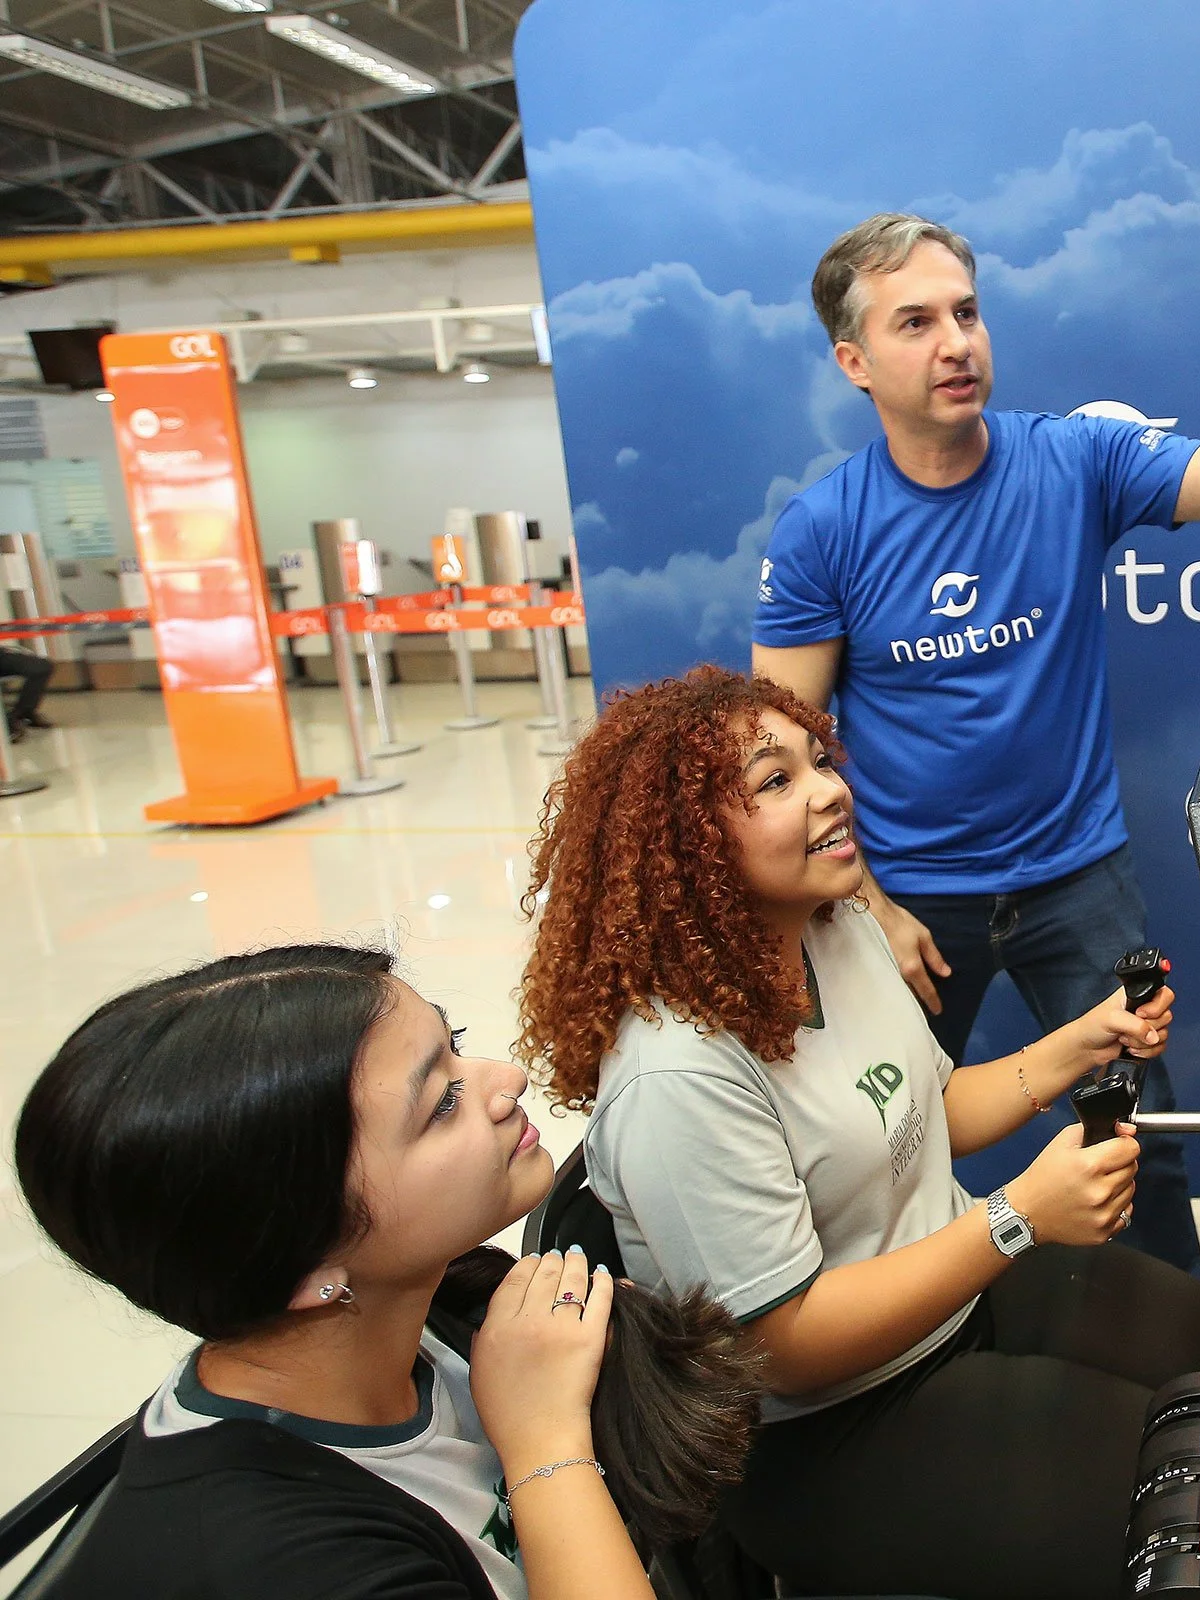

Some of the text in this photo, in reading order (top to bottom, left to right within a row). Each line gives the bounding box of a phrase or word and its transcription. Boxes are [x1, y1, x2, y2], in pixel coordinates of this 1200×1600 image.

[170, 335, 218, 358] GOL
[364, 614, 398, 631] GOL
[425, 611, 461, 630] GOL
[488, 609, 523, 629] GOL
[550, 606, 584, 625] GOL
[290, 616, 324, 635] GOL
[1157, 1467, 1189, 1481] PROP
